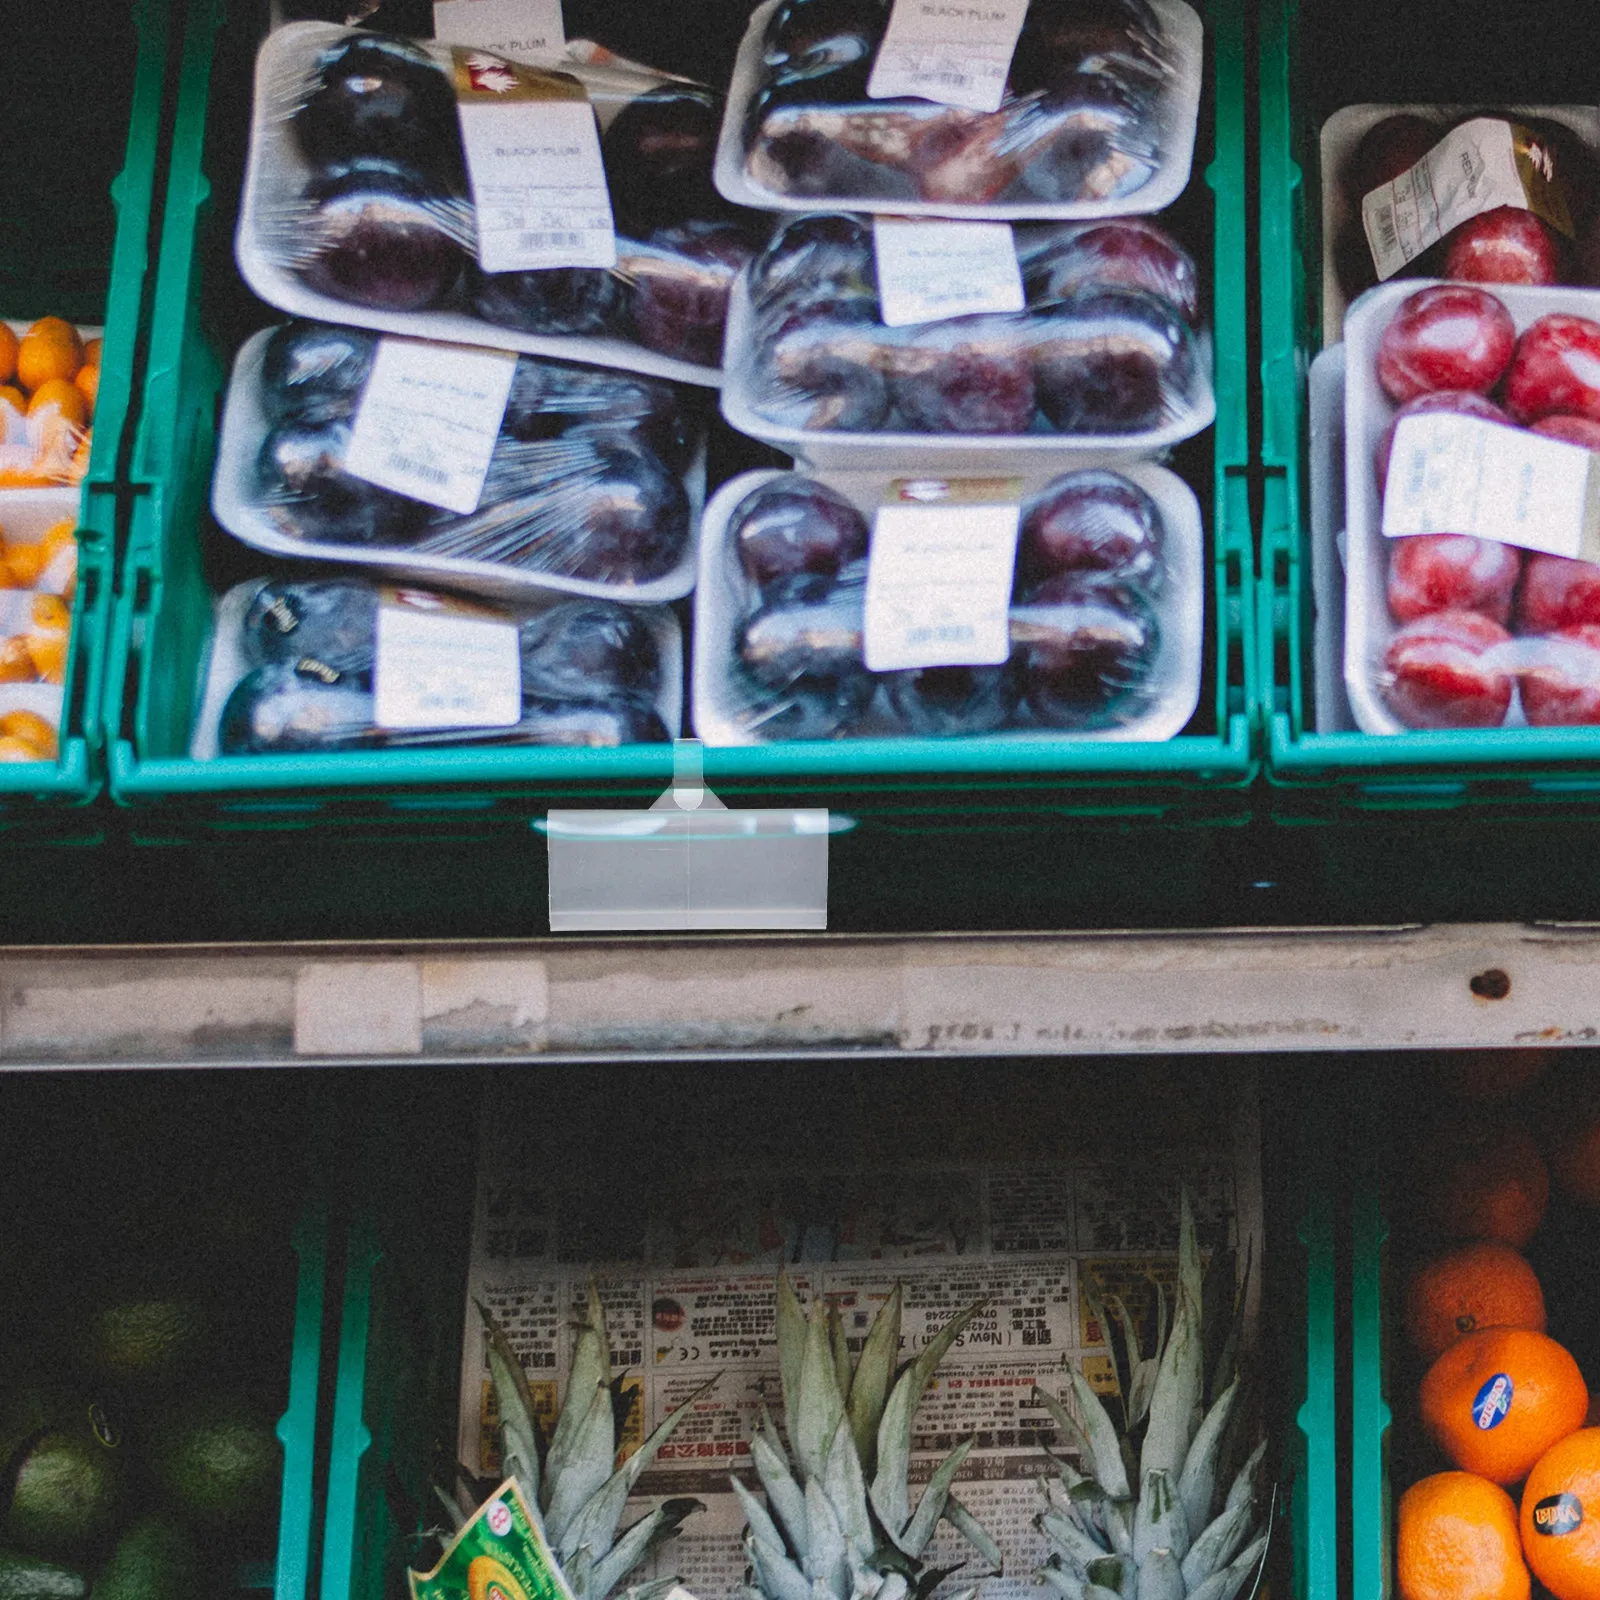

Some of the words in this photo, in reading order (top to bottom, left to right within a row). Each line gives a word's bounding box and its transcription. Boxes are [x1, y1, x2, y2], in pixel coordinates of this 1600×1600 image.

[508, 37, 548, 52] PLUM
[1460, 151, 1473, 176] RED
[968, 1332, 1002, 1346] New
